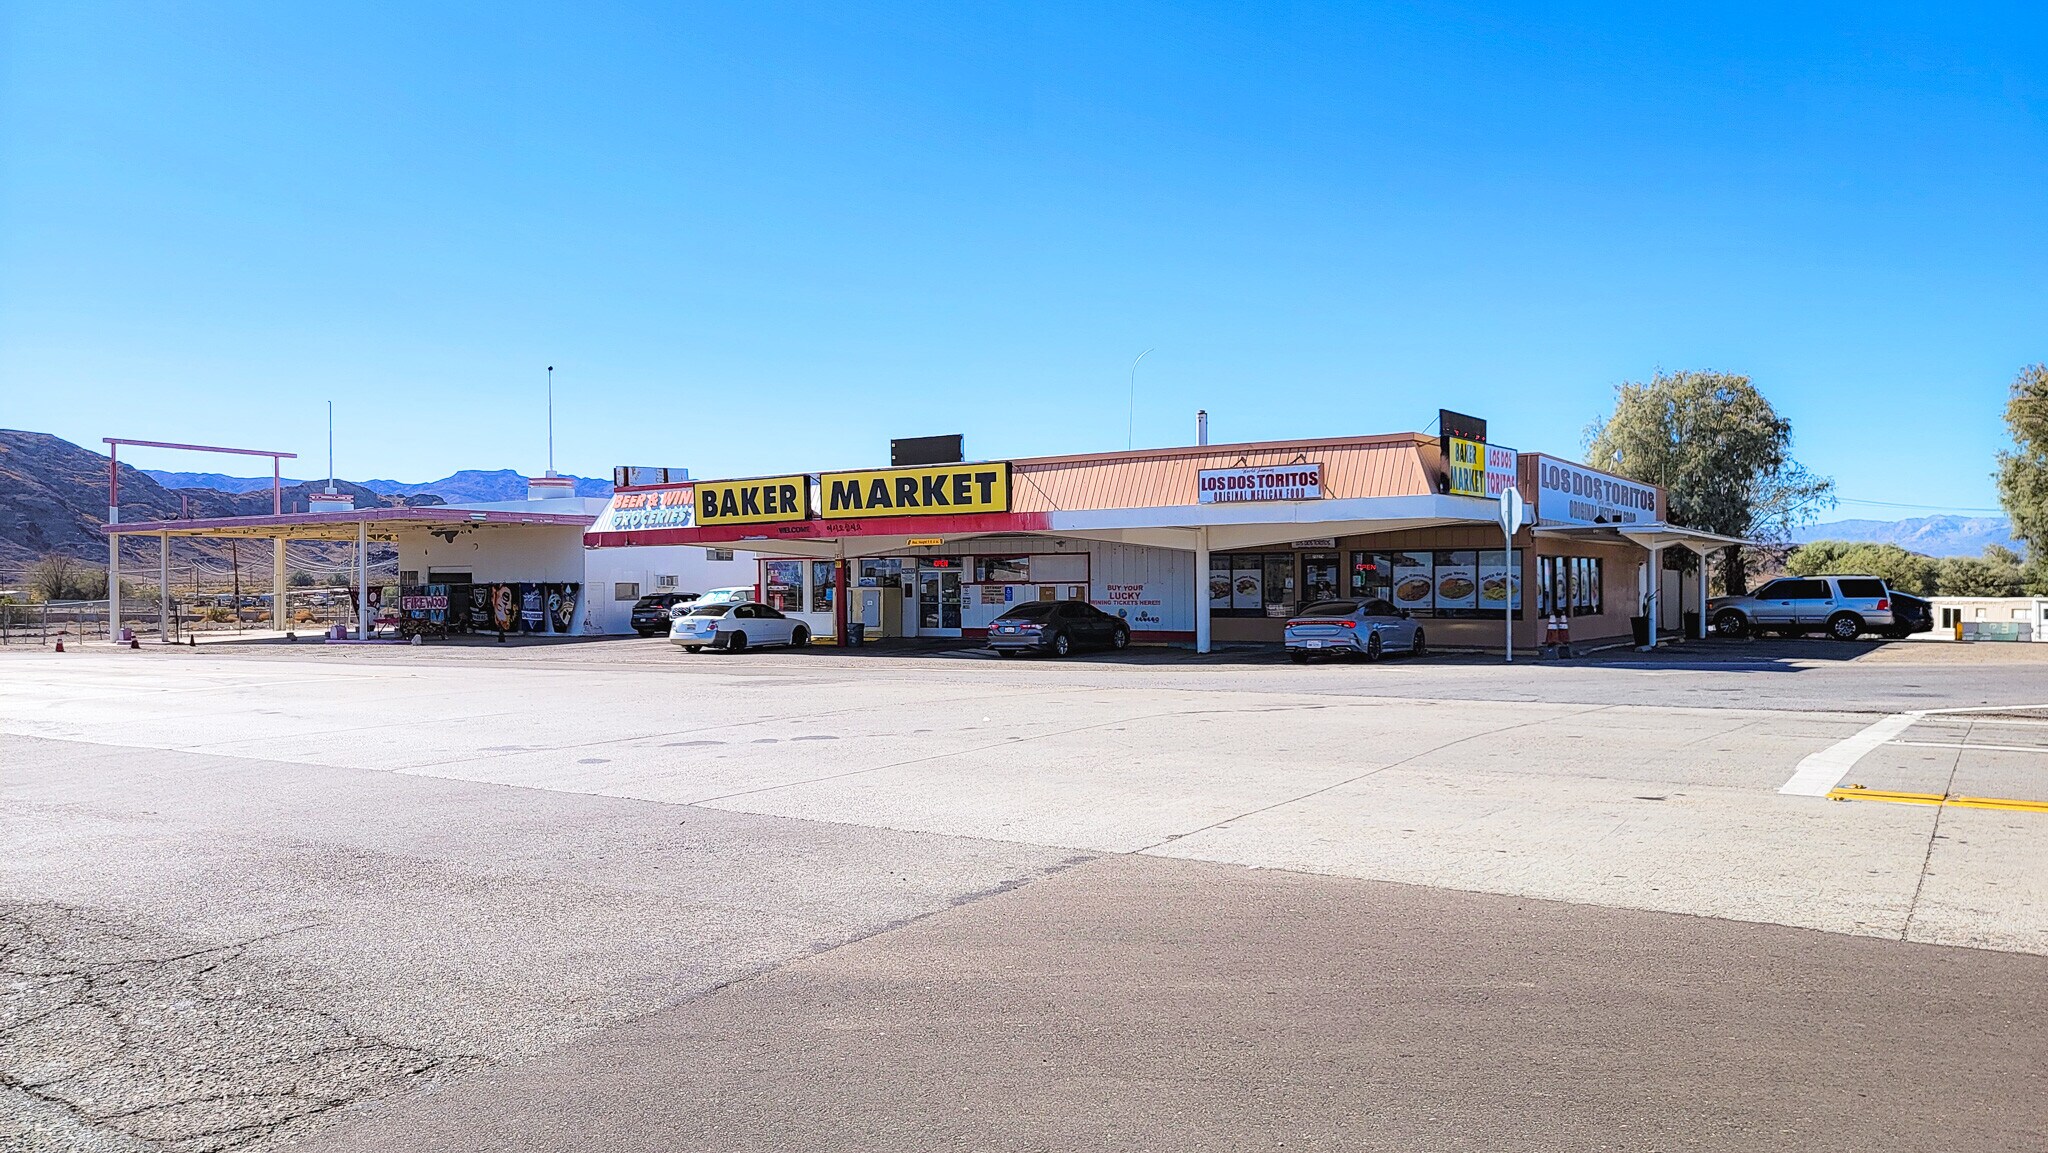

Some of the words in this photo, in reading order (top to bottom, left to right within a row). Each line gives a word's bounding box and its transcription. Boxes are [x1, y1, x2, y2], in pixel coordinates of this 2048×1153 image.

[1455, 443, 1476, 464] BAKER
[1489, 449, 1499, 467] LOS
[1501, 450, 1512, 469] DOS
[1201, 477, 1226, 491] LOS
[1227, 475, 1255, 489] DOS
[1257, 471, 1318, 488] TORITOS
[1451, 465, 1484, 492] MARKET
[1541, 463, 1571, 493] LOS
[1572, 472, 1602, 503] DOS
[1603, 480, 1655, 512] TORITOS
[613, 493, 646, 510] BEER
[647, 492, 659, 508] &
[702, 484, 798, 518] BAKER
[829, 471, 996, 511] MARKET
[1213, 491, 1248, 502] ORIGINAL
[1251, 488, 1283, 501] MEXICAN
[1286, 487, 1305, 499] FOOD
[612, 508, 689, 529] GROCERIES
[1569, 500, 1597, 521] ORIGINAL
[778, 525, 811, 533] WELCOME
[933, 559, 949, 568] OPEN
[403, 597, 449, 610] FIREWOOD
[1110, 592, 1141, 600] LUCKY
